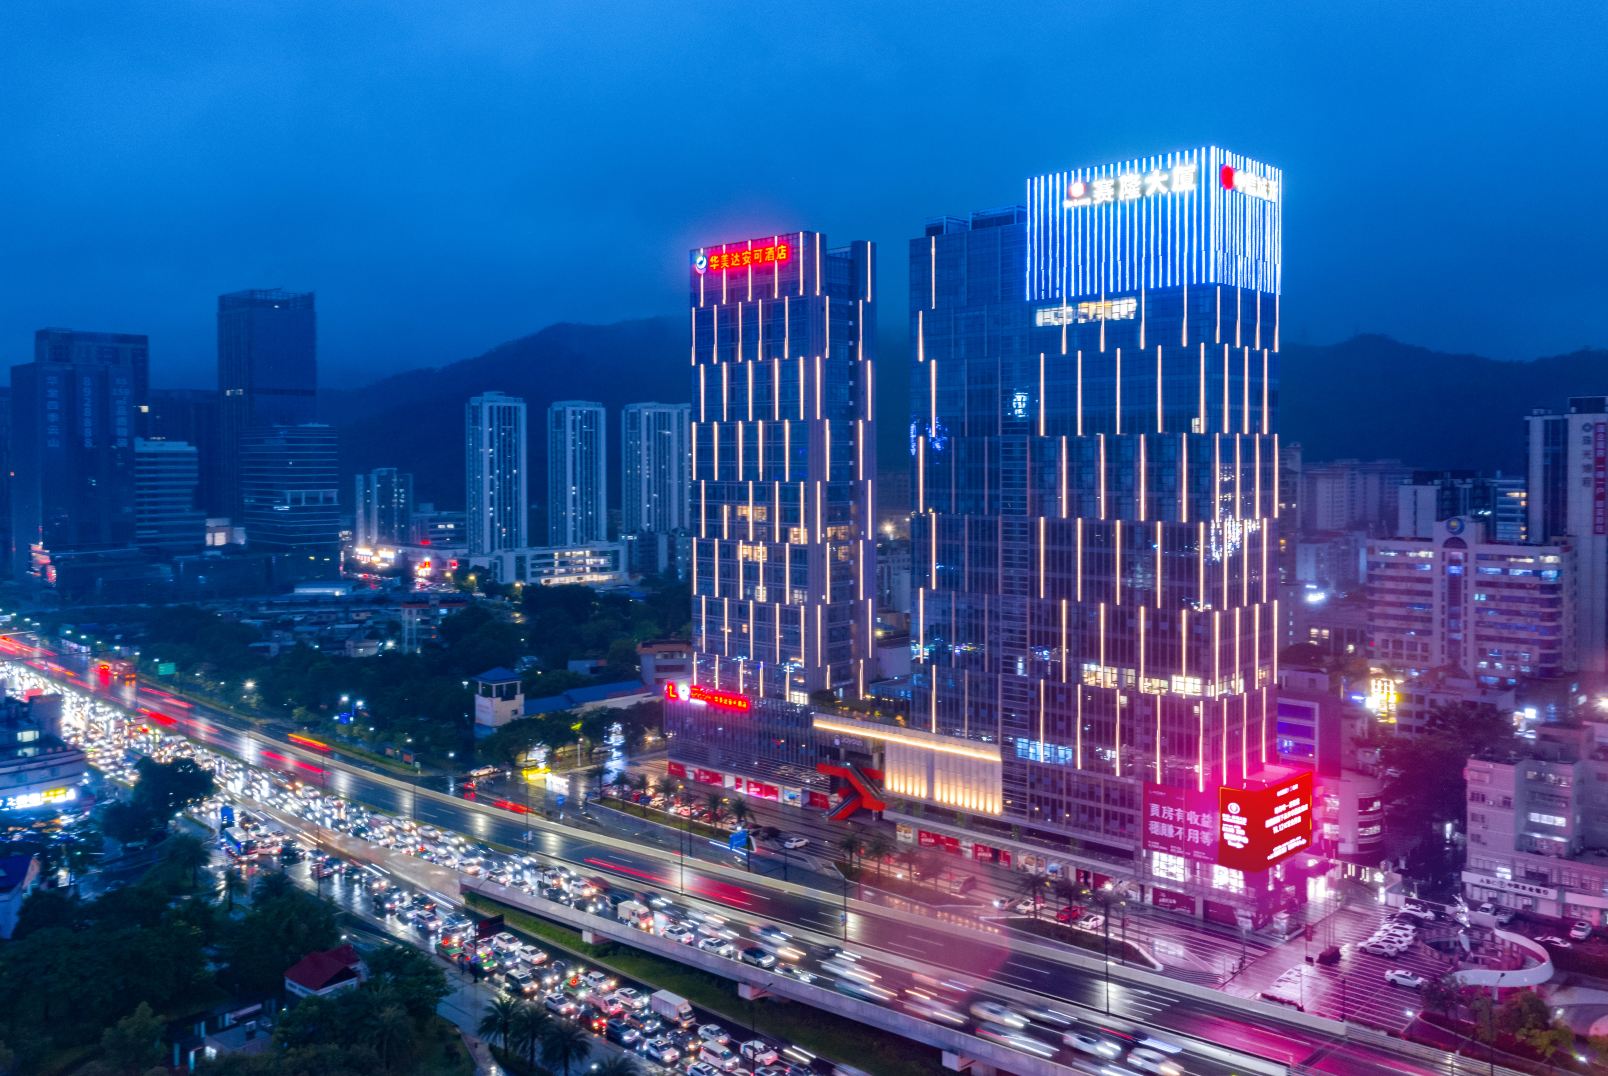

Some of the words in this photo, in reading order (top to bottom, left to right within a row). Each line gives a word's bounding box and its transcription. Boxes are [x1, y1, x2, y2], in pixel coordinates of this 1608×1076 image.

[710, 245, 788, 269] 华美达安可酒店
